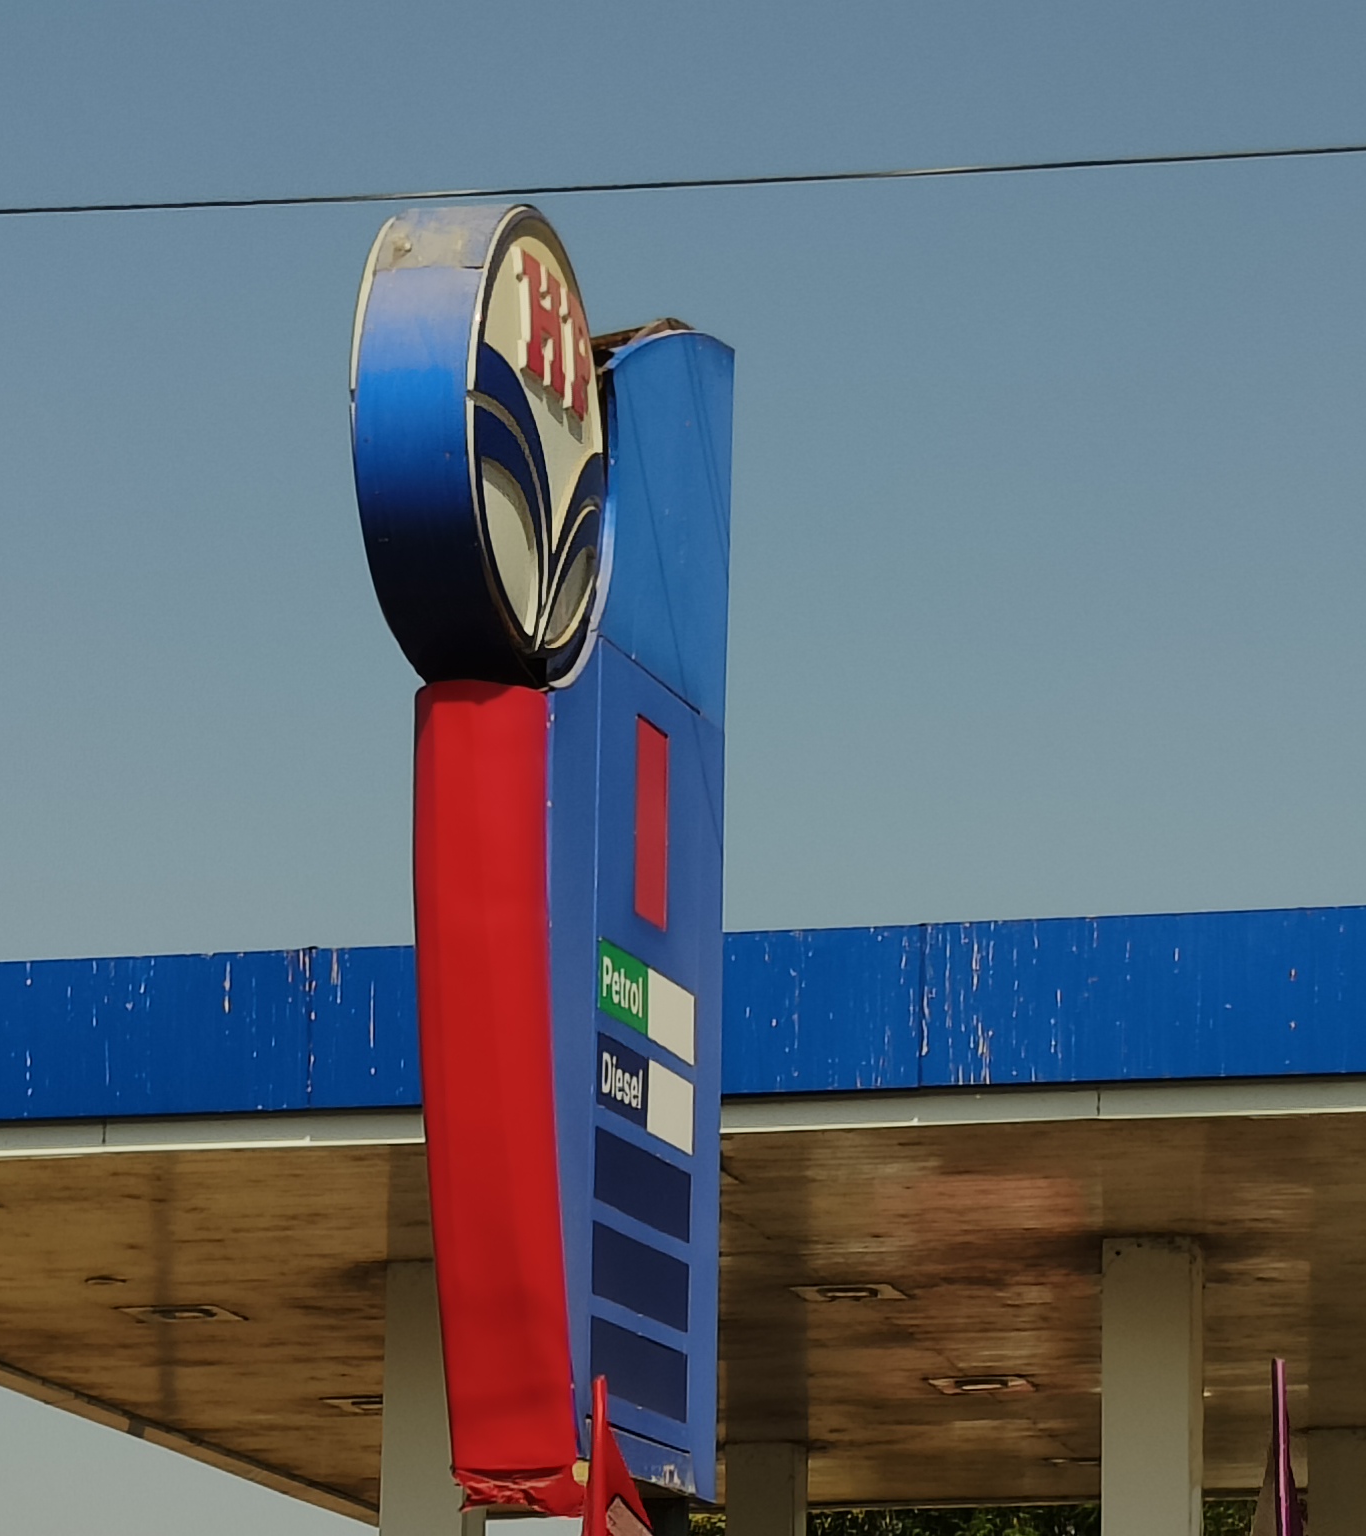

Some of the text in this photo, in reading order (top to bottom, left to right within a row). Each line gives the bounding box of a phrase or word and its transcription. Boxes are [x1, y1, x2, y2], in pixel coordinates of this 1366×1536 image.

[513, 246, 592, 422] HP
[602, 955, 644, 1018] Petrol
[601, 1051, 644, 1110] Diesel
